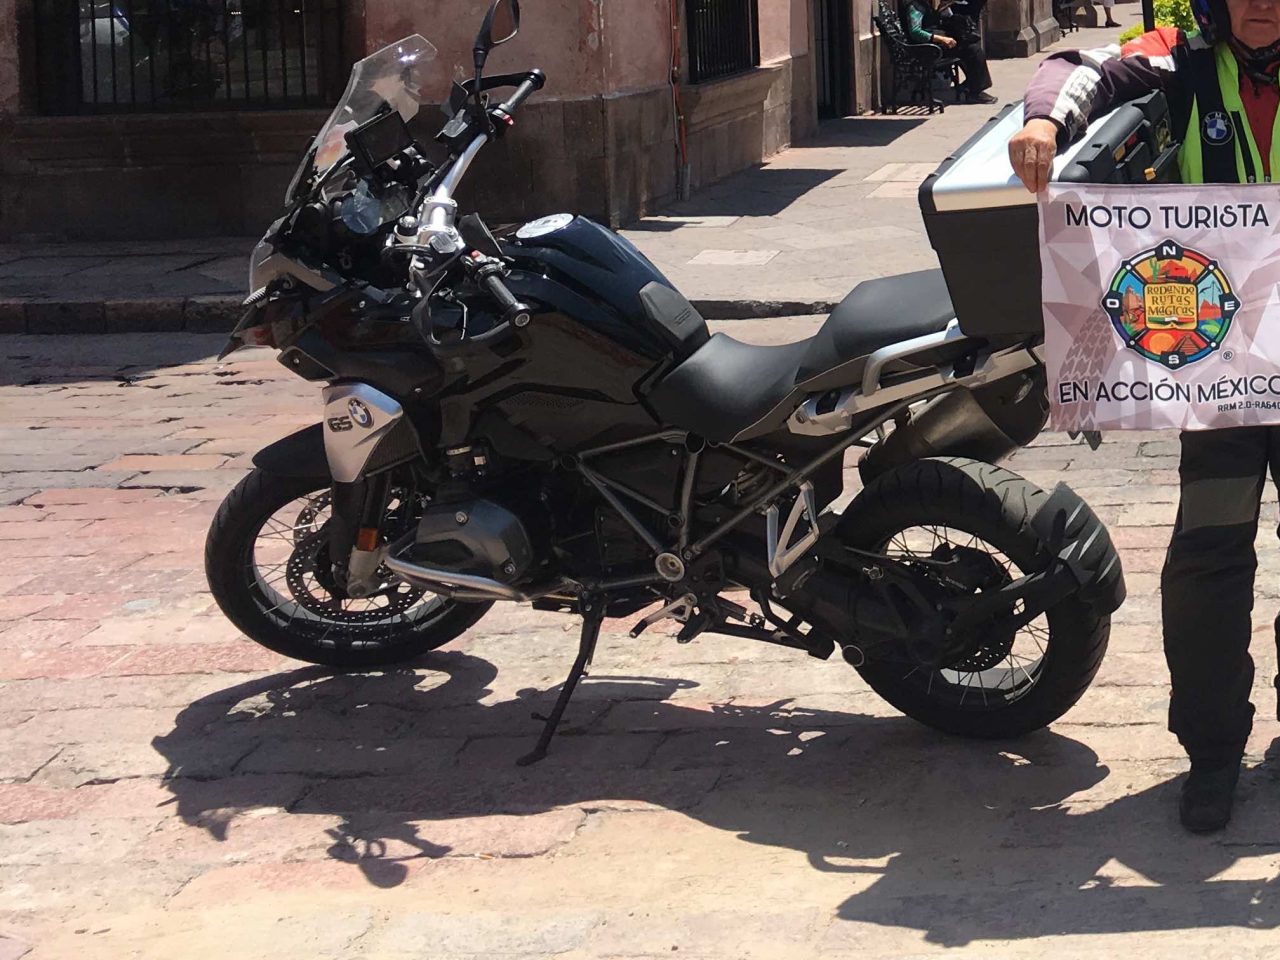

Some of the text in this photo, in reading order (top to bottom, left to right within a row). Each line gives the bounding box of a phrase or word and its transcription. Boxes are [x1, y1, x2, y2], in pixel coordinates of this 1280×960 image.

[1065, 203, 1270, 229] MOTO TURISTA
[1162, 245, 1176, 256] N
[1224, 300, 1235, 311] E
[1168, 354, 1180, 365] S
[1059, 380, 1089, 404] EN
[1095, 377, 1191, 403] ACCIÓN
[1217, 402, 1237, 413] RRM
[327, 416, 353, 433] GS
